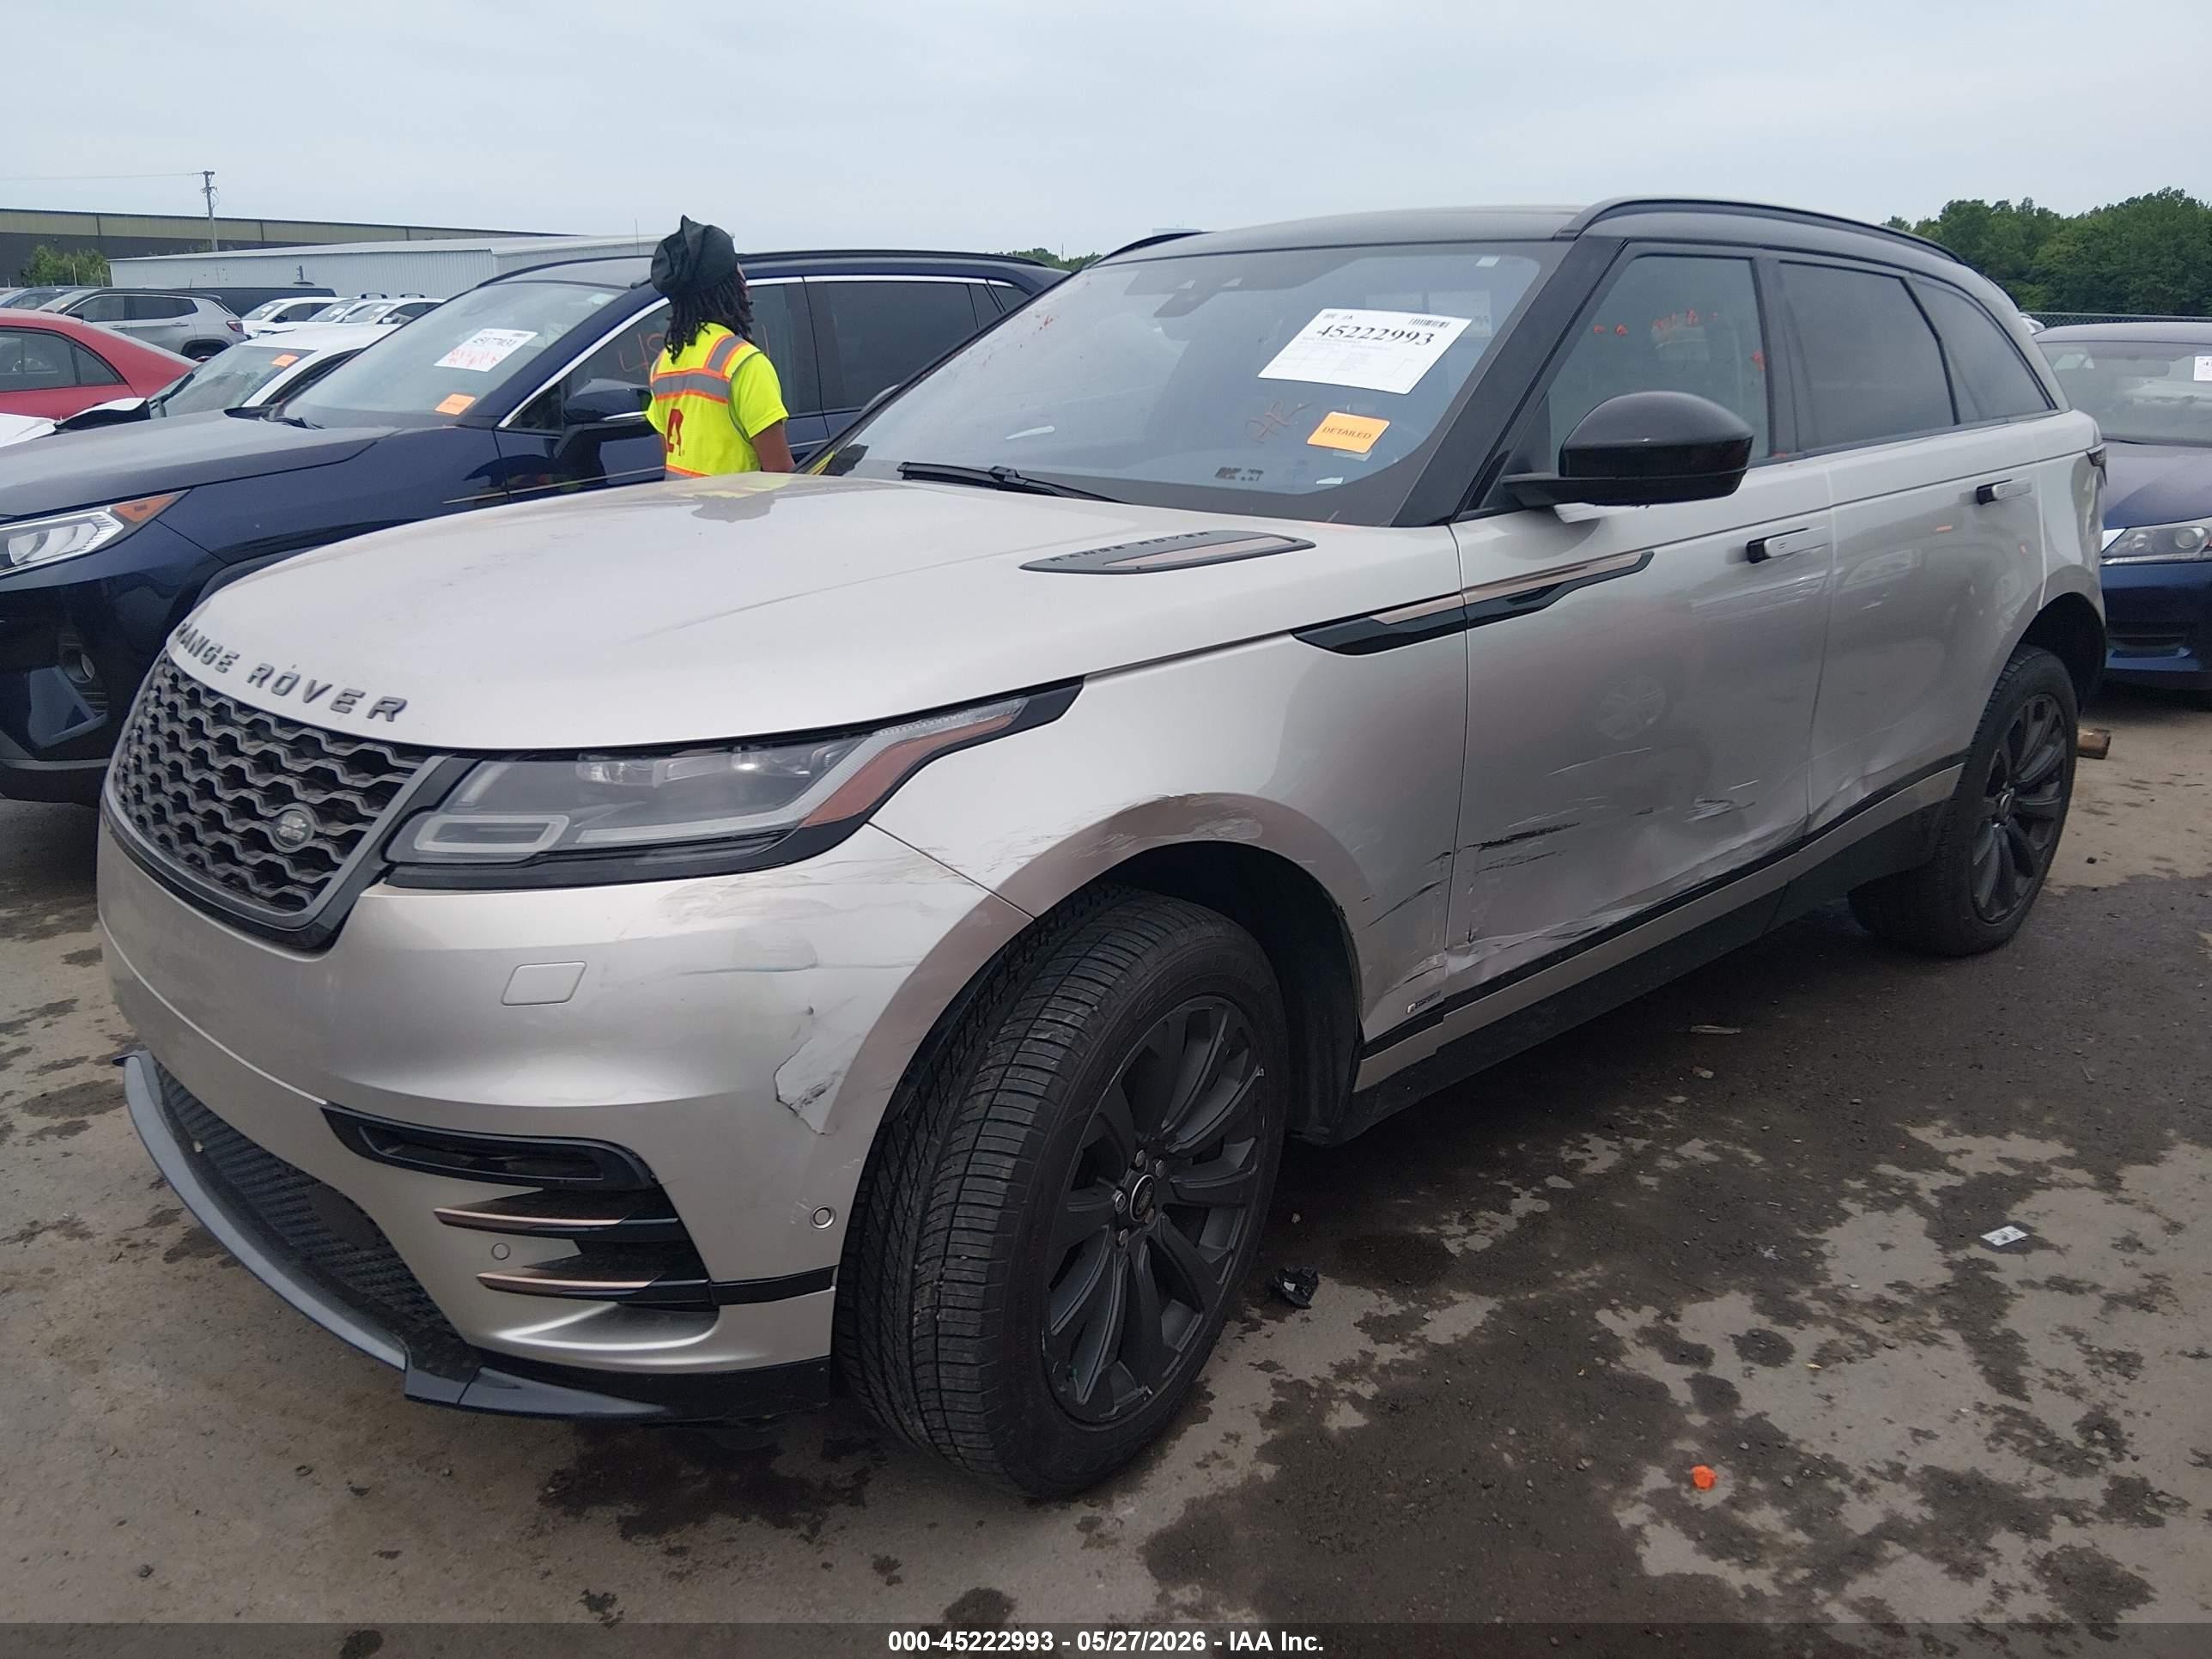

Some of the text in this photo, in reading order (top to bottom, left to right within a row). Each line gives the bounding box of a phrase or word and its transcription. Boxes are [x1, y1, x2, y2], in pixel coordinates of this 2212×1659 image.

[1316, 324, 1435, 346] 45222993
[1322, 426, 1372, 440] DETAILED
[174, 622, 408, 722] RANGE ROVER
